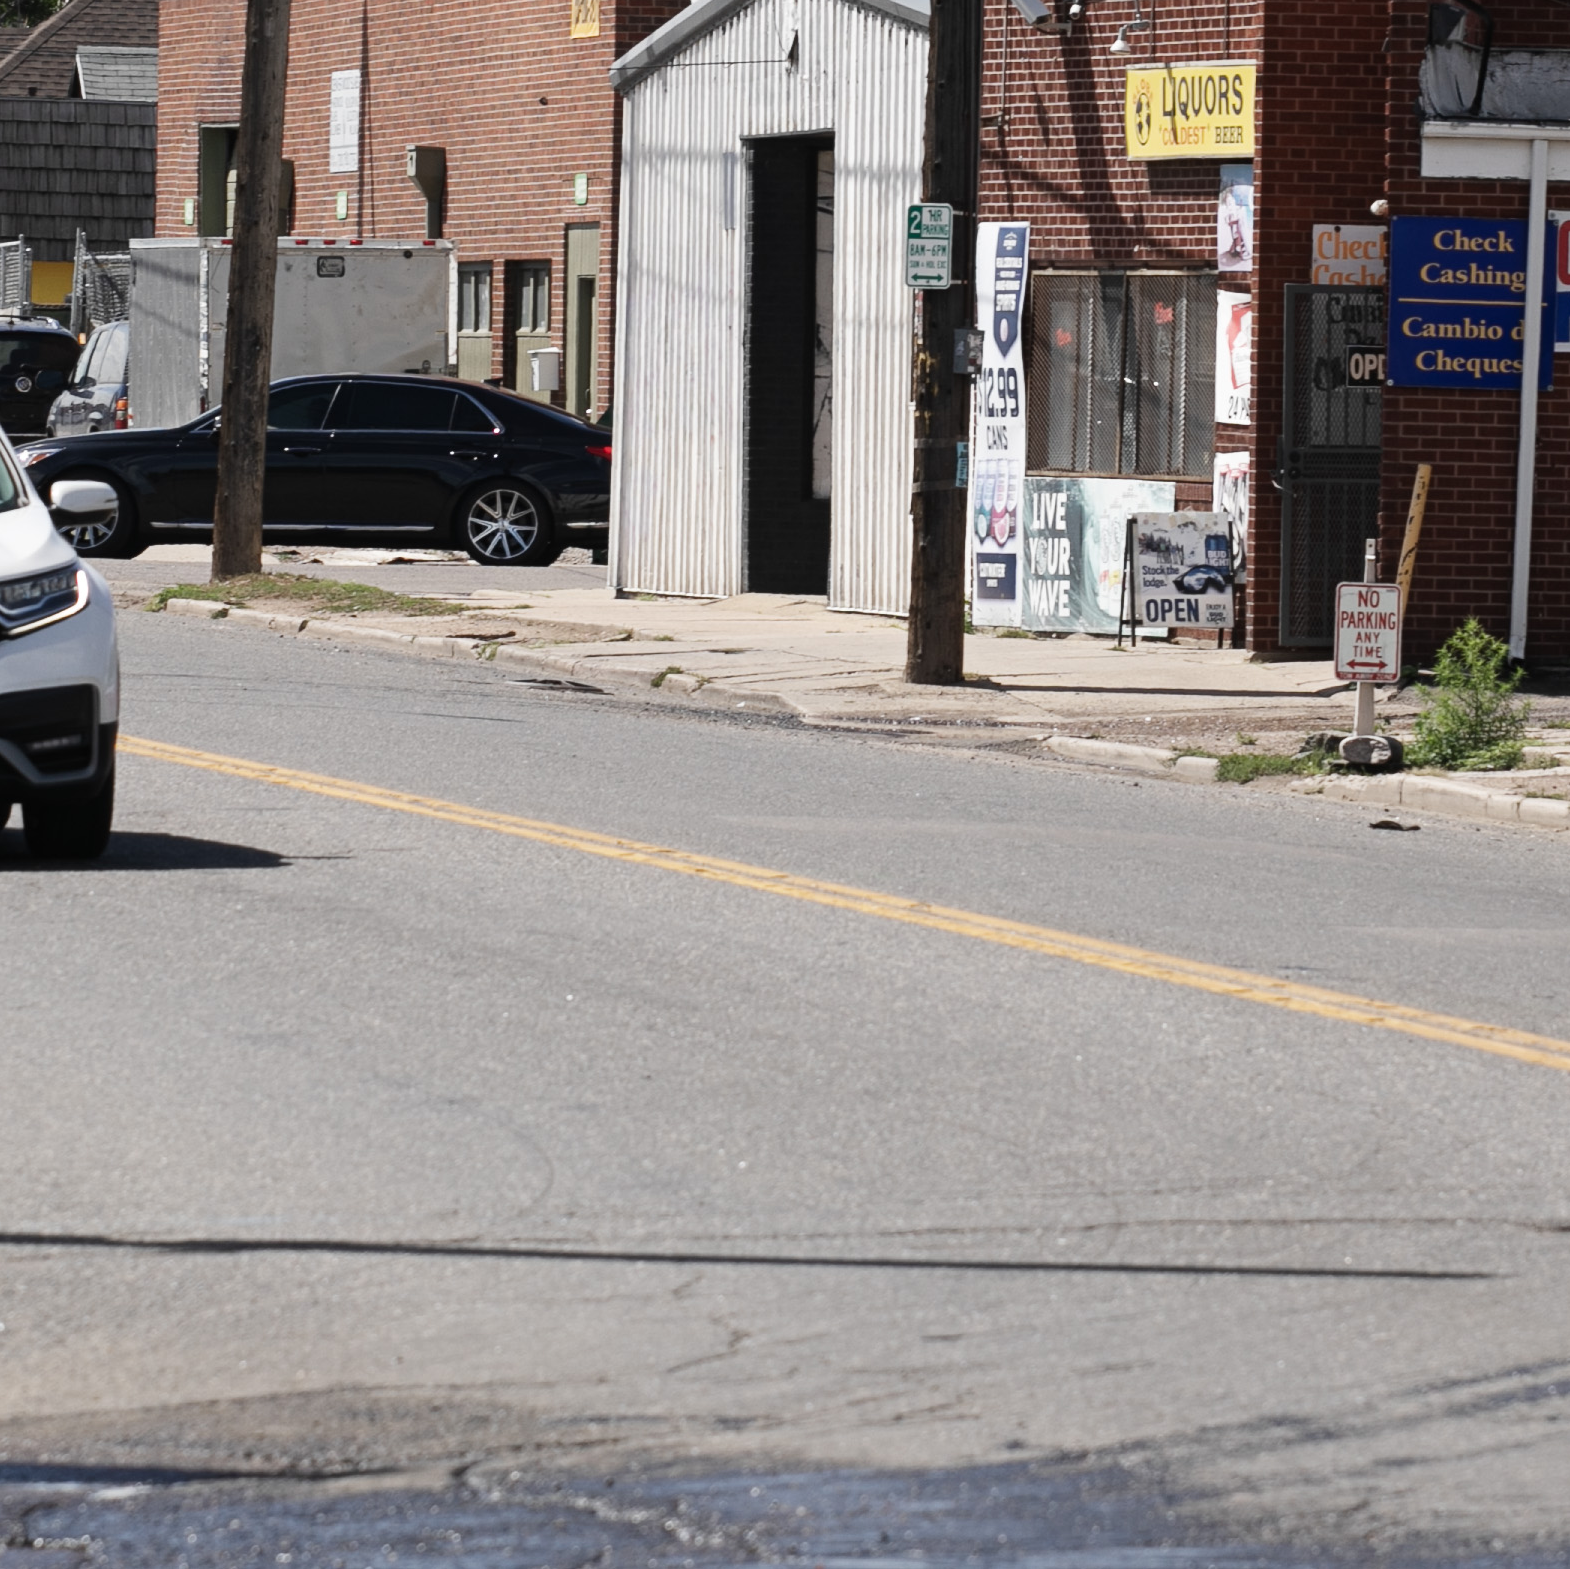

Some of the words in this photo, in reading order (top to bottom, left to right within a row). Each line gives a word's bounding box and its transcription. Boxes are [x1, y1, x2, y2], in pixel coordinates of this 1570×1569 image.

[1163, 74, 1243, 121] LIQUORS
[1215, 125, 1244, 144] BEER
[910, 211, 921, 234] 2
[923, 223, 948, 236] PARKING
[1433, 231, 1514, 252] Check
[1420, 263, 1526, 292] Cashing
[1402, 317, 1504, 341] Cambio
[1511, 321, 1524, 341] d
[1350, 352, 1386, 380] OPE
[1415, 350, 1523, 378] Cheques
[987, 425, 1008, 450] CANS
[1032, 493, 1068, 530] LIVE
[1028, 537, 1071, 575] YOUR
[1207, 550, 1227, 559] BUD
[1142, 565, 1166, 575] Stock
[1166, 566, 1179, 575] the
[1028, 579, 1071, 617] WAVE
[1357, 590, 1380, 608] NO
[1145, 598, 1200, 622] OPEN
[1340, 611, 1396, 630] PARKING
[1355, 632, 1380, 643] ANY
[1352, 645, 1383, 659] TIME
